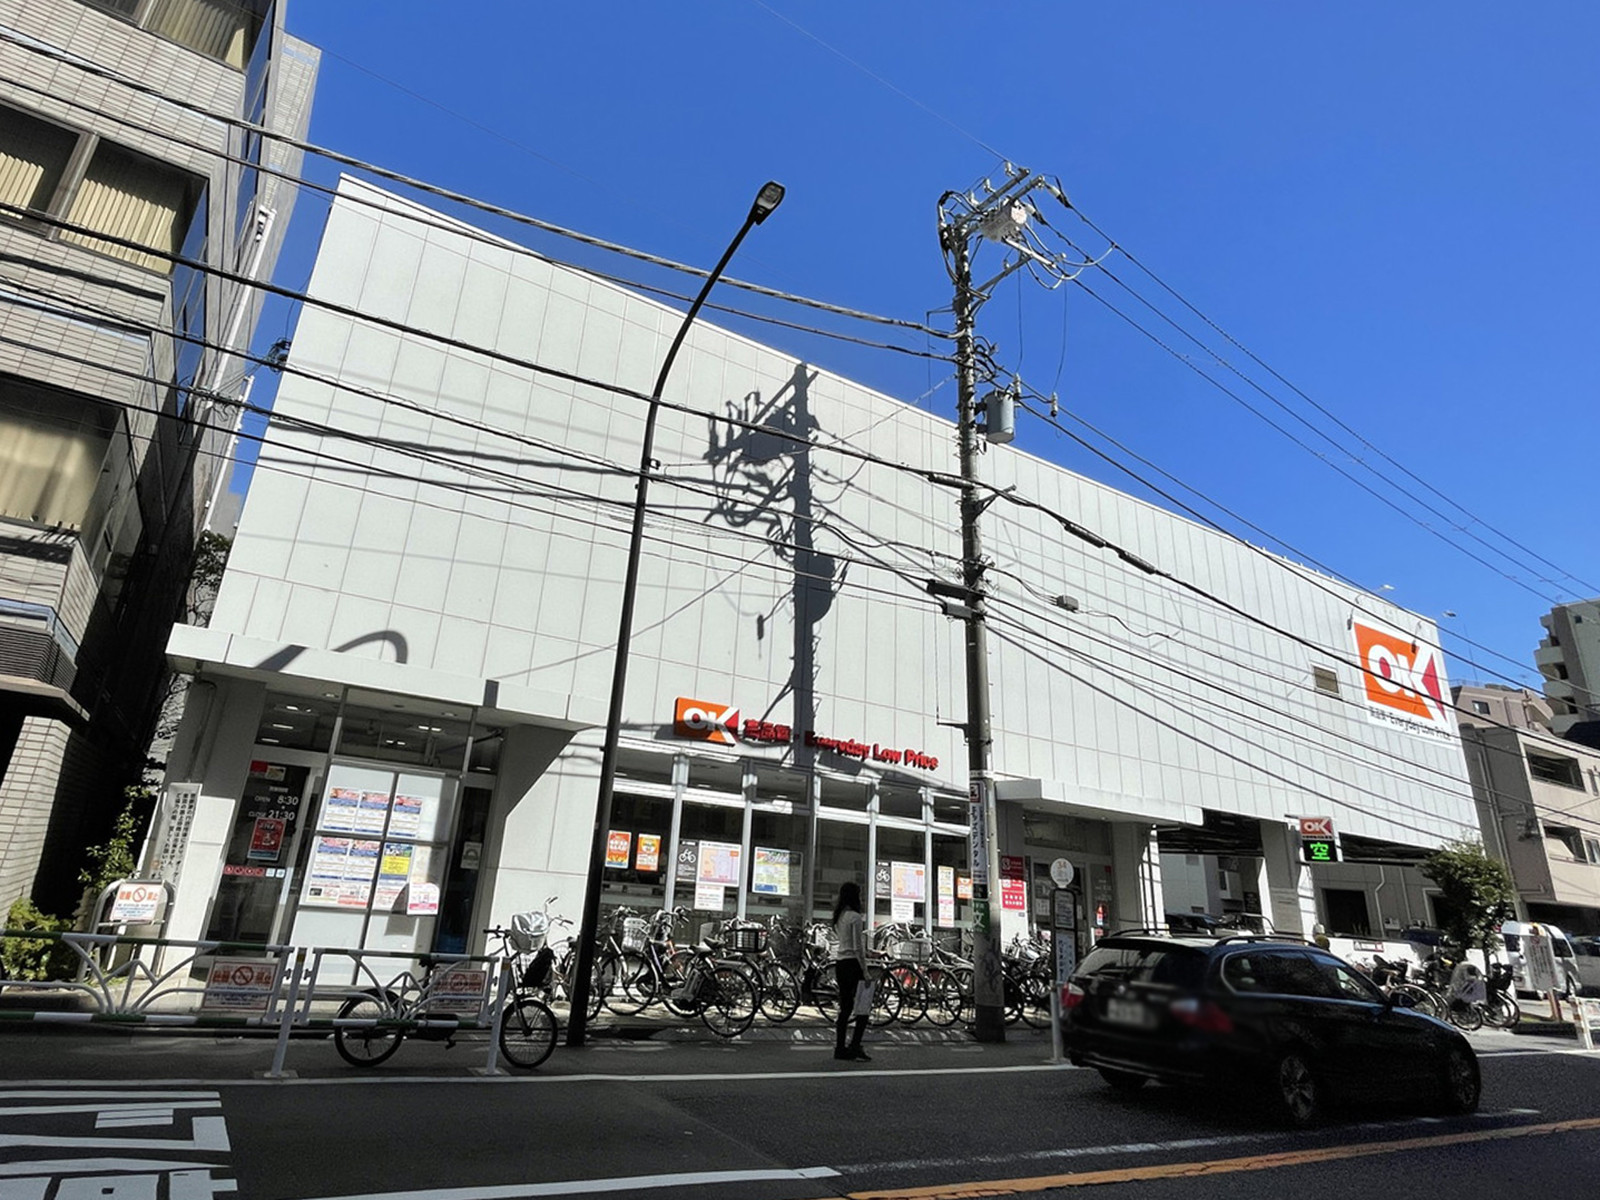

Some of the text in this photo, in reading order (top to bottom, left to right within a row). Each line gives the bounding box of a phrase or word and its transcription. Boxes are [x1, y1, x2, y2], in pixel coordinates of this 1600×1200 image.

[1368, 645, 1446, 721] OK
[683, 706, 739, 745] OK
[874, 744, 902, 764] Low
[904, 750, 939, 770] Price
[277, 795, 299, 805] 8:30
[268, 810, 295, 820] 21:30
[1304, 818, 1332, 836] OK
[1310, 842, 1330, 860] 空
[972, 909, 985, 928] 文
